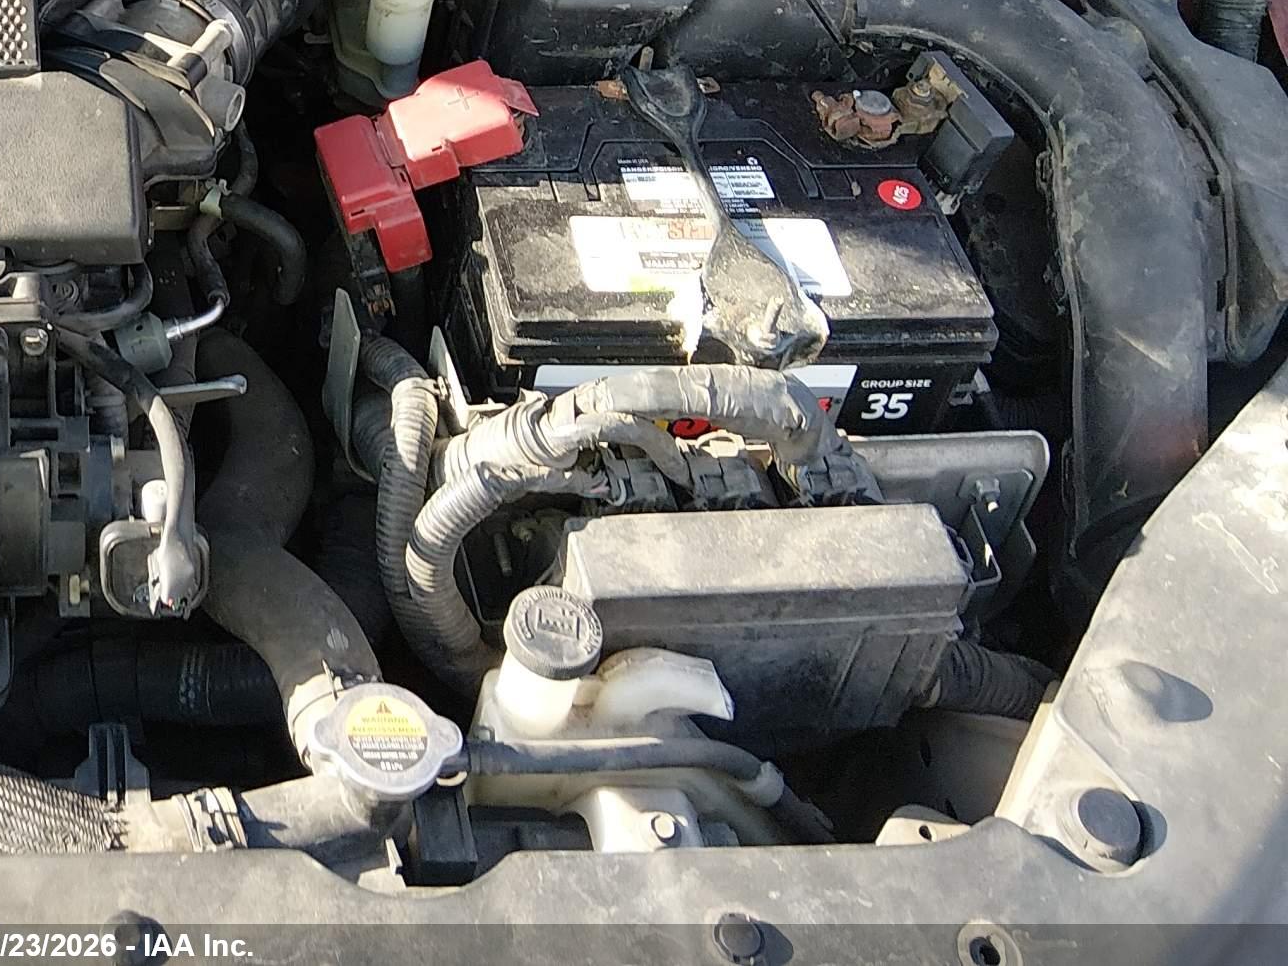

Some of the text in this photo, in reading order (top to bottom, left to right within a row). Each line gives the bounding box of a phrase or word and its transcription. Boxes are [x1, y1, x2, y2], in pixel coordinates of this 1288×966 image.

[861, 379, 932, 388] GROUP SIZE
[861, 392, 914, 420] 35
